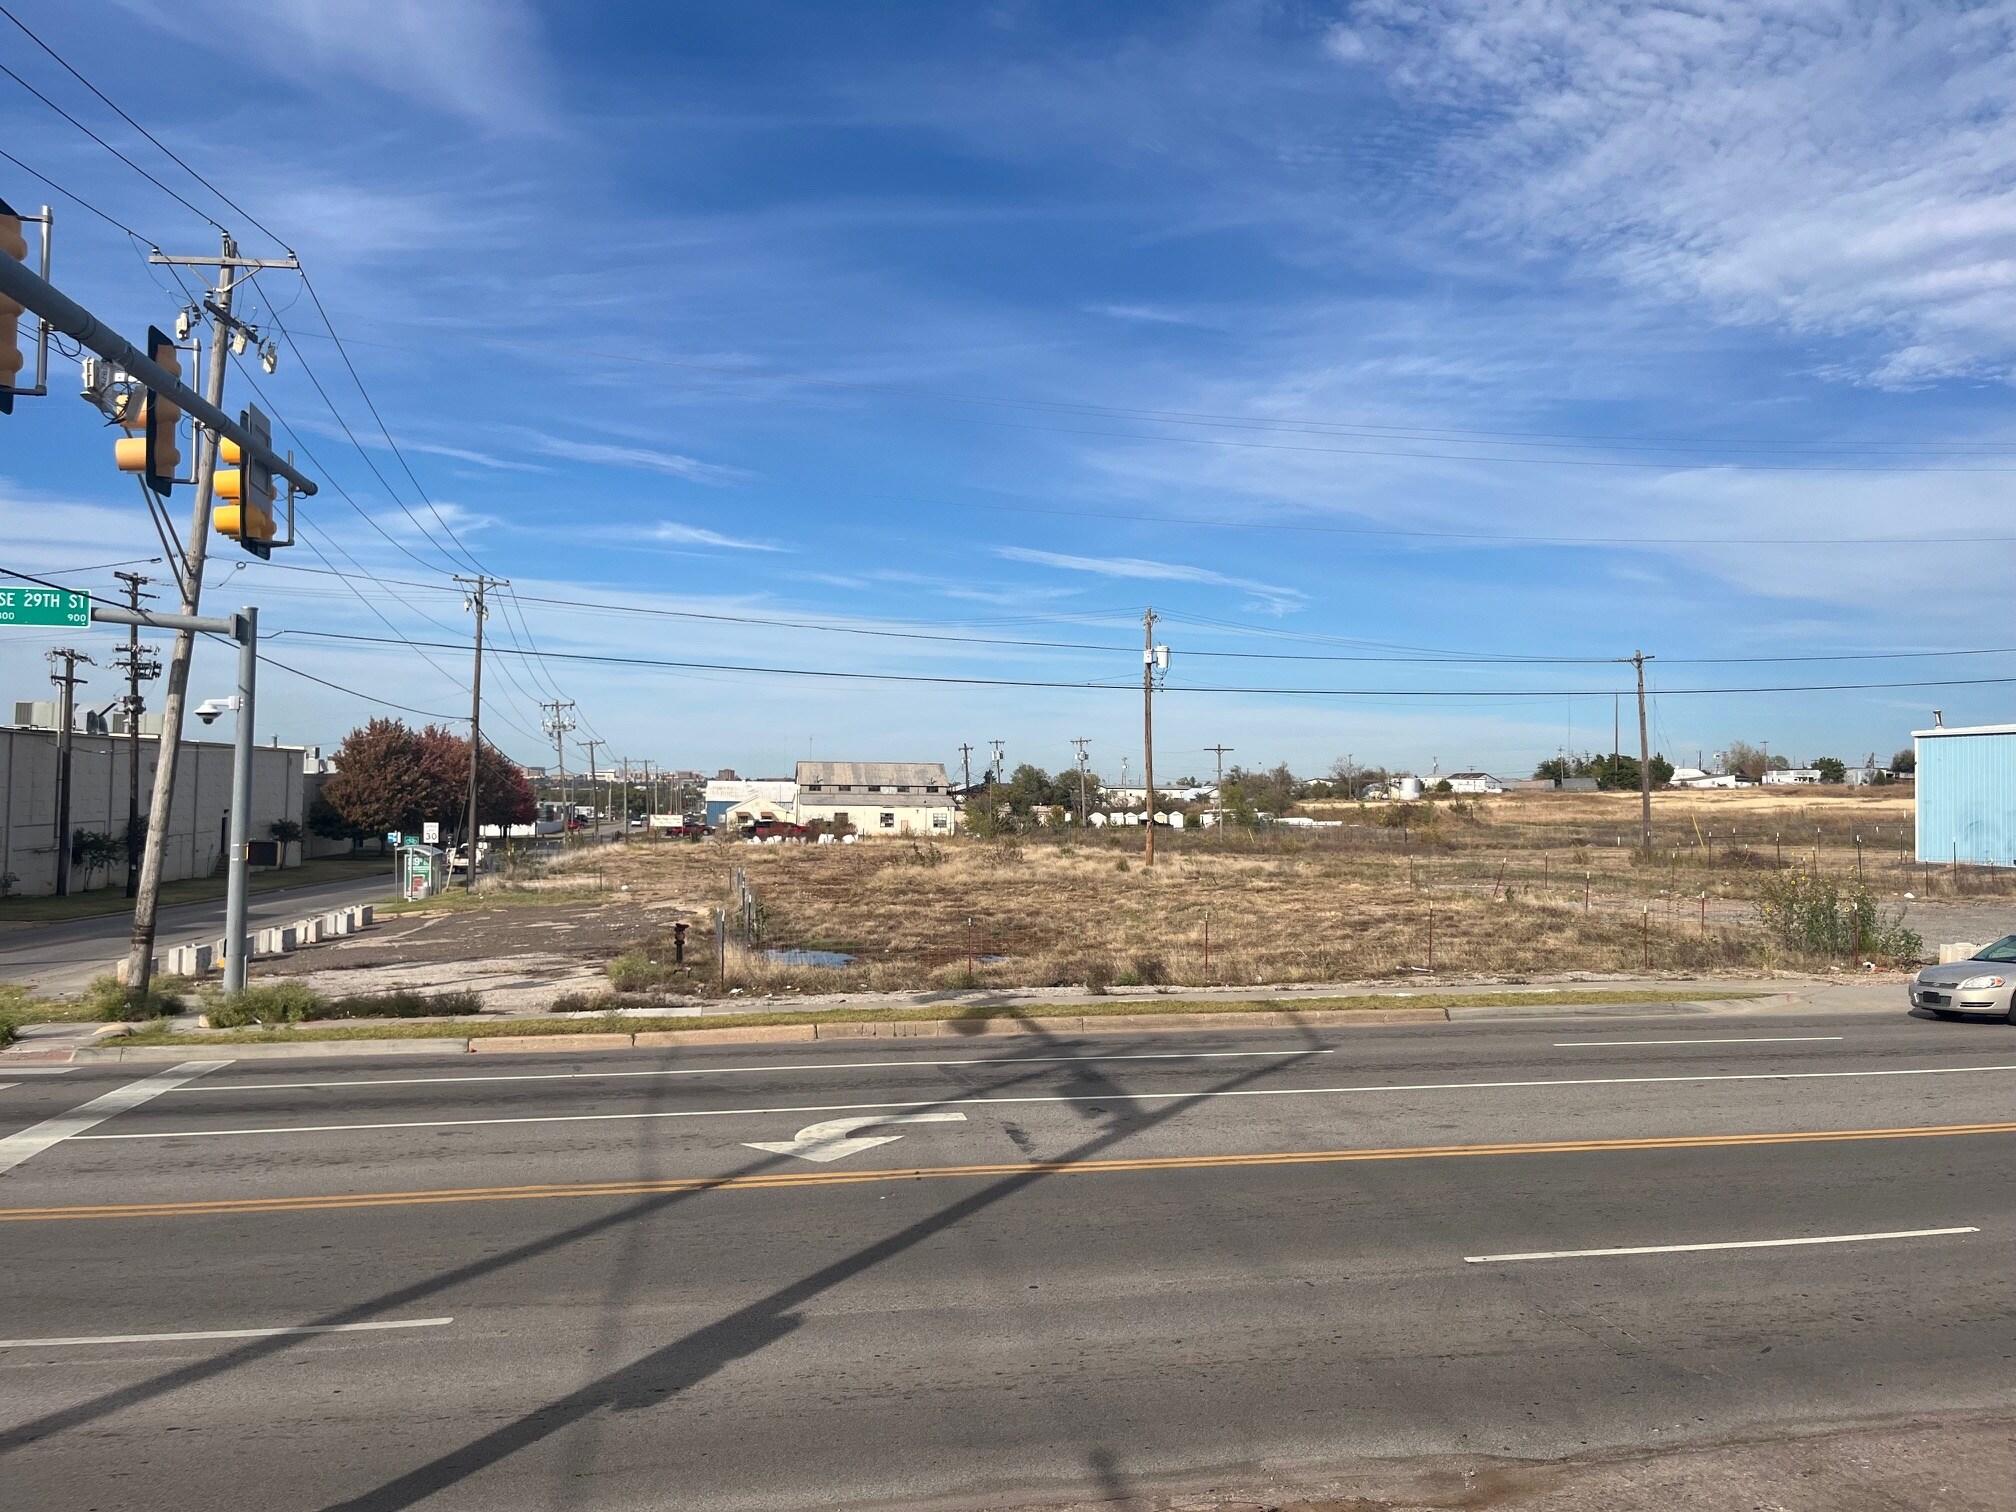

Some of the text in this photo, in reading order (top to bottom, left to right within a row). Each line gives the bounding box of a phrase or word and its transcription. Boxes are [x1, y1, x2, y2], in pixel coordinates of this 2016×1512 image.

[0, 592, 85, 608] SE 29TH ST
